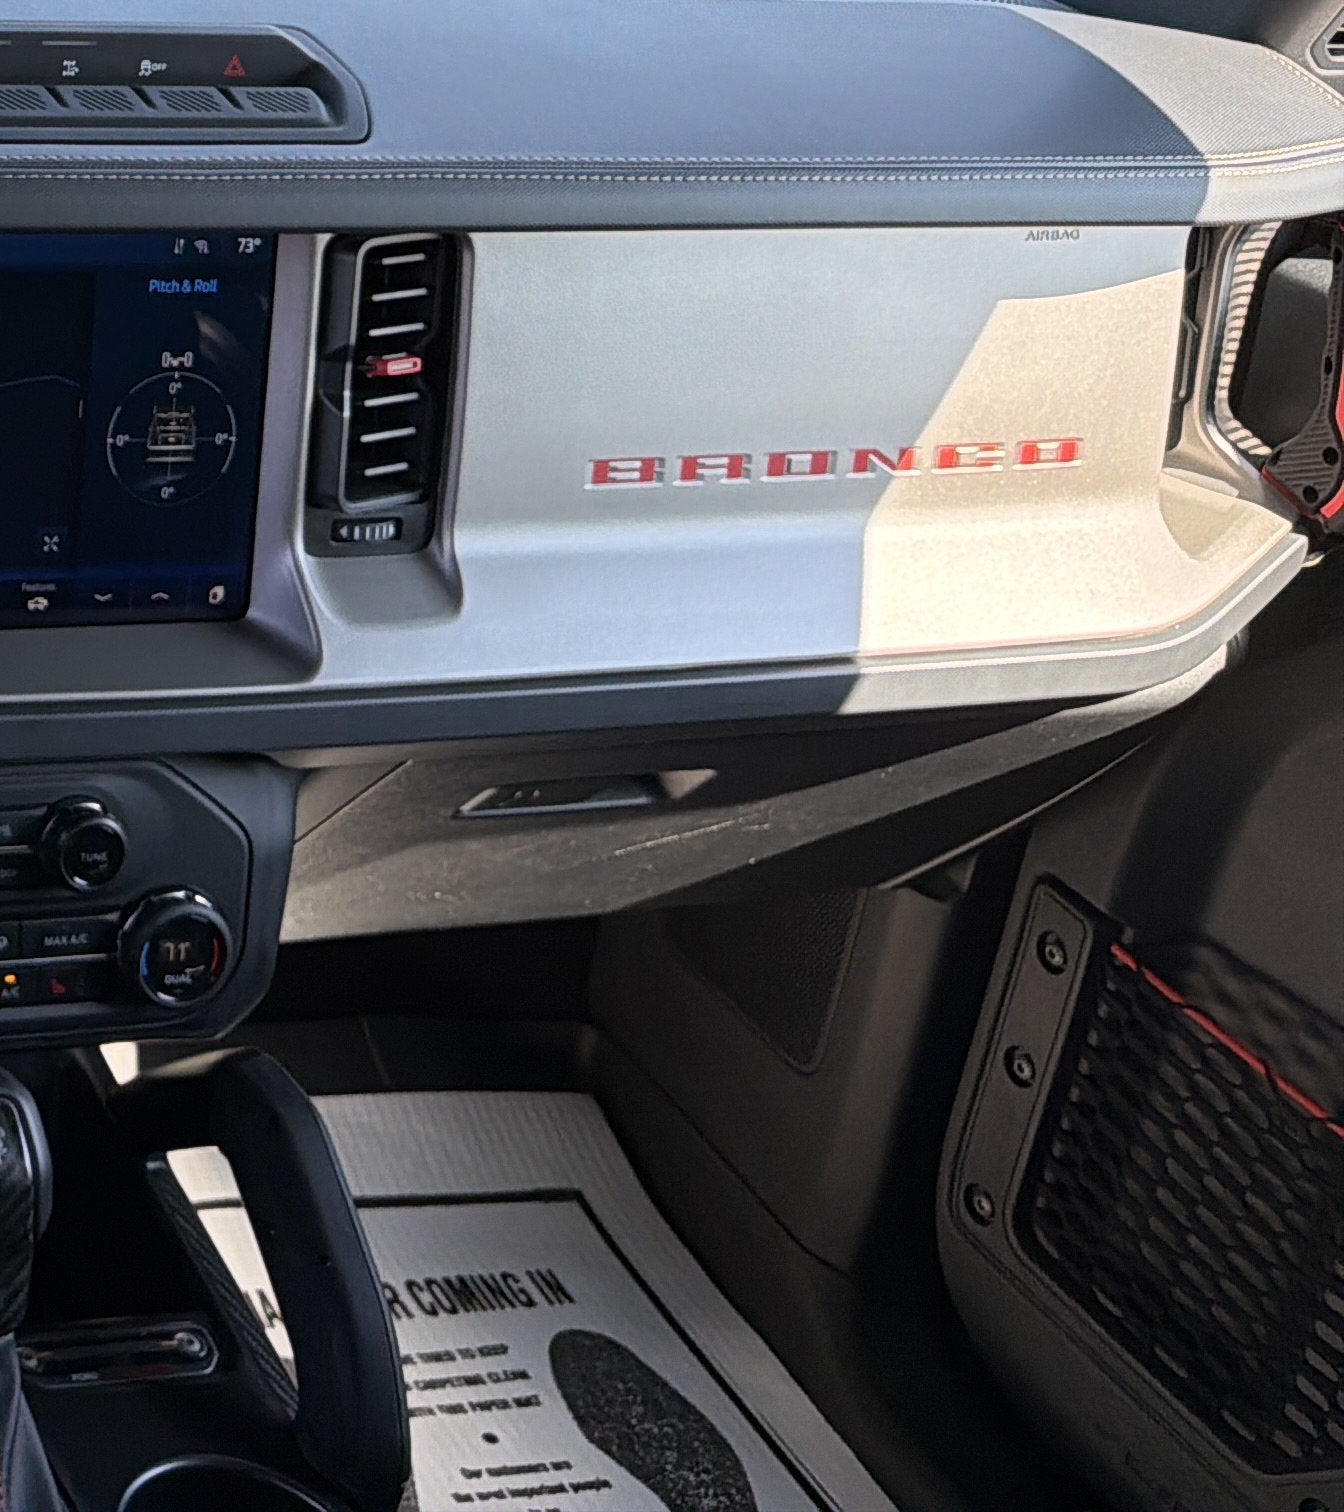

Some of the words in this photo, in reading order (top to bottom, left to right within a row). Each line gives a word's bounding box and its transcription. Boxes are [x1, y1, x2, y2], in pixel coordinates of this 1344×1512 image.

[148, 279, 180, 294] Pitch
[194, 279, 218, 294] Roll
[585, 437, 1084, 489] BRONCO
[404, 1270, 539, 1319] COMING
[524, 1268, 576, 1307] IN
